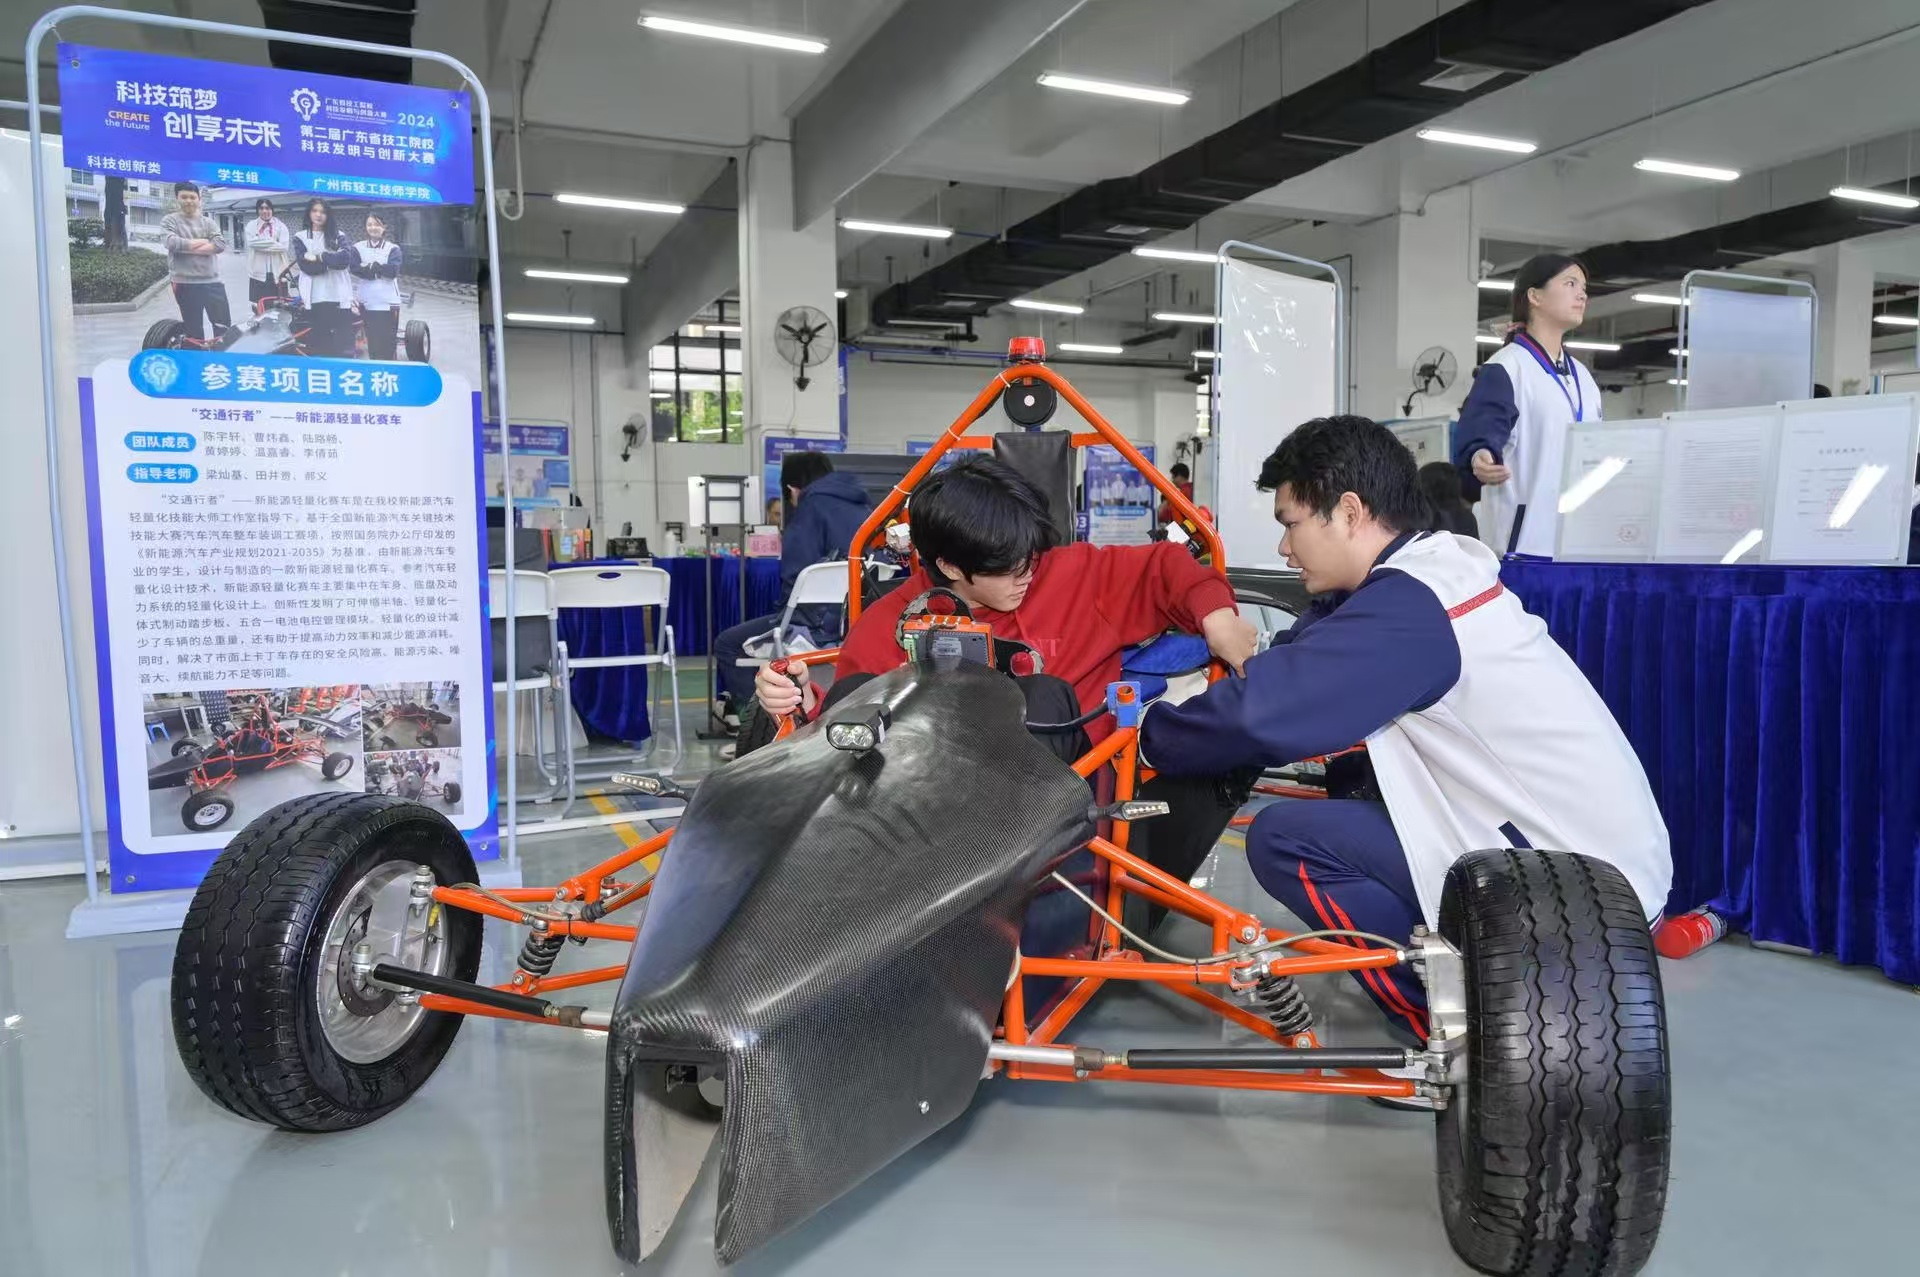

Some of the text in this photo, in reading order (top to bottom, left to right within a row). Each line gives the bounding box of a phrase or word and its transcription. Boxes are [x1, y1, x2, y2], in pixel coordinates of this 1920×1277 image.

[116, 80, 218, 111] 科技筑梦
[105, 118, 150, 130] the future
[108, 110, 150, 123] CREATE
[397, 113, 435, 128] 2024
[163, 111, 282, 148] 创享未来
[300, 125, 435, 150] 第二届广东省技工院校
[301, 139, 436, 165] 科技发明与创新大赛
[87, 155, 161, 175] 科技创新类
[217, 168, 260, 184] 学生组
[313, 178, 431, 200] 广州市轻工技师学院
[201, 362, 400, 398] 参赛项目名称
[131, 435, 190, 450] 团队成员
[133, 467, 192, 481] 指导老师
